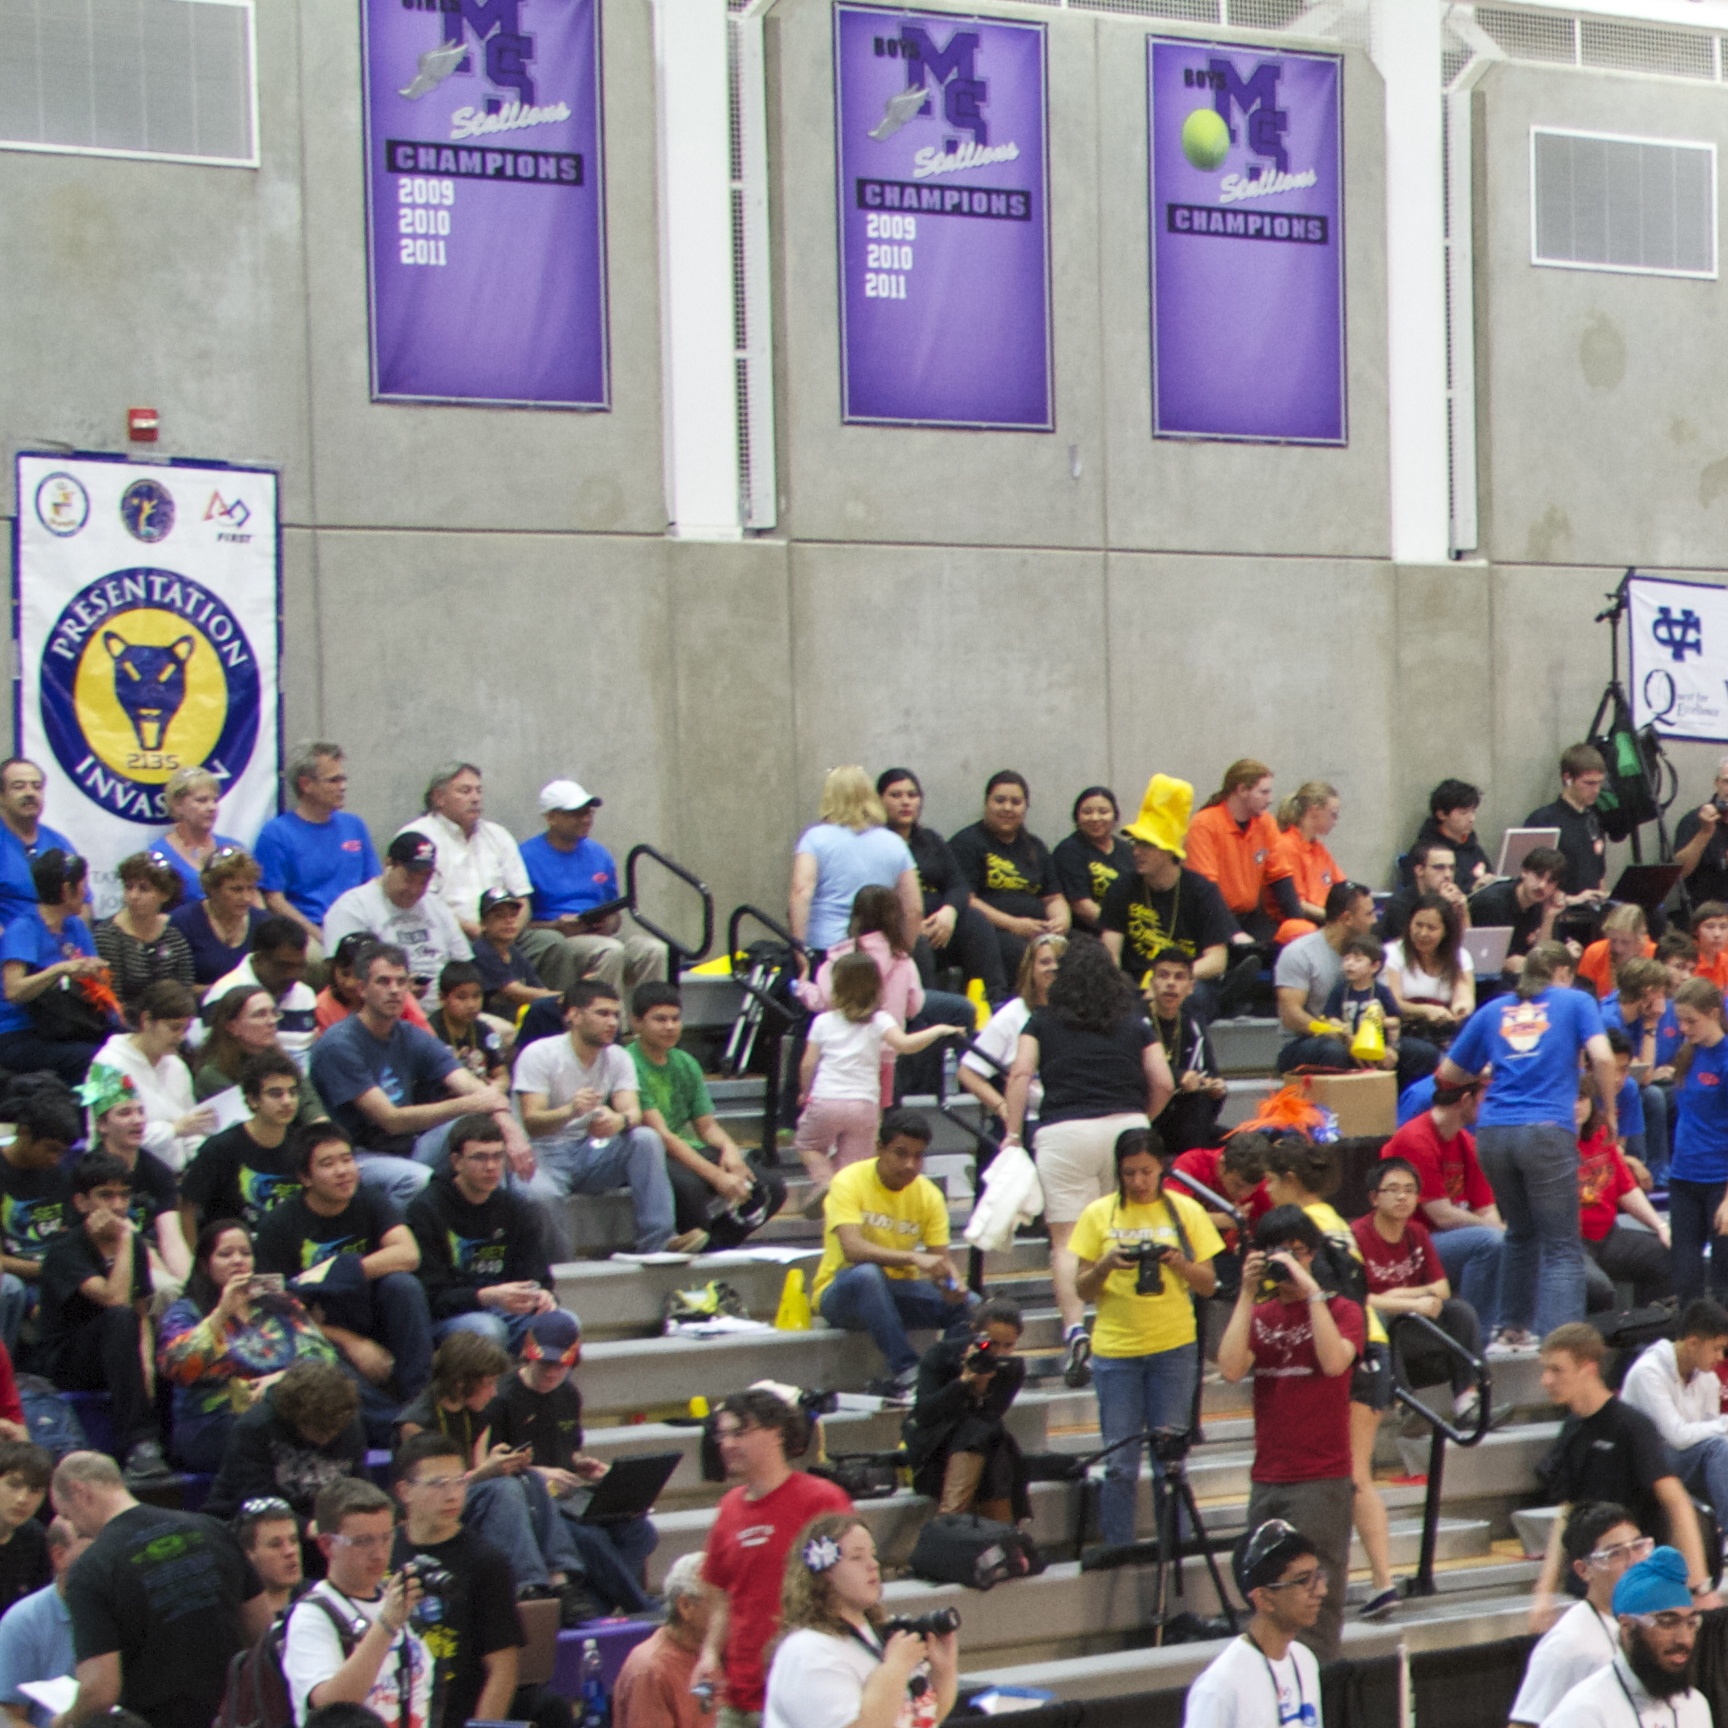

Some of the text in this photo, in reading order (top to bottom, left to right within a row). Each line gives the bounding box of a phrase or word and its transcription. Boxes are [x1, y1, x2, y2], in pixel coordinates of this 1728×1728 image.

[394, 145, 578, 181] CHAMPIONS
[398, 178, 454, 206] 2009
[864, 184, 1027, 216] CHAMPIONS
[399, 208, 451, 236] 2010
[866, 214, 916, 240] 2009
[1174, 210, 1324, 241] CHAMPIONS
[400, 239, 447, 266] 2011
[867, 245, 913, 270] 2010
[865, 274, 907, 299] 2011
[51, 574, 249, 668] PRESENTATION
[126, 752, 180, 770] 2135
[74, 753, 232, 823] INVASN
